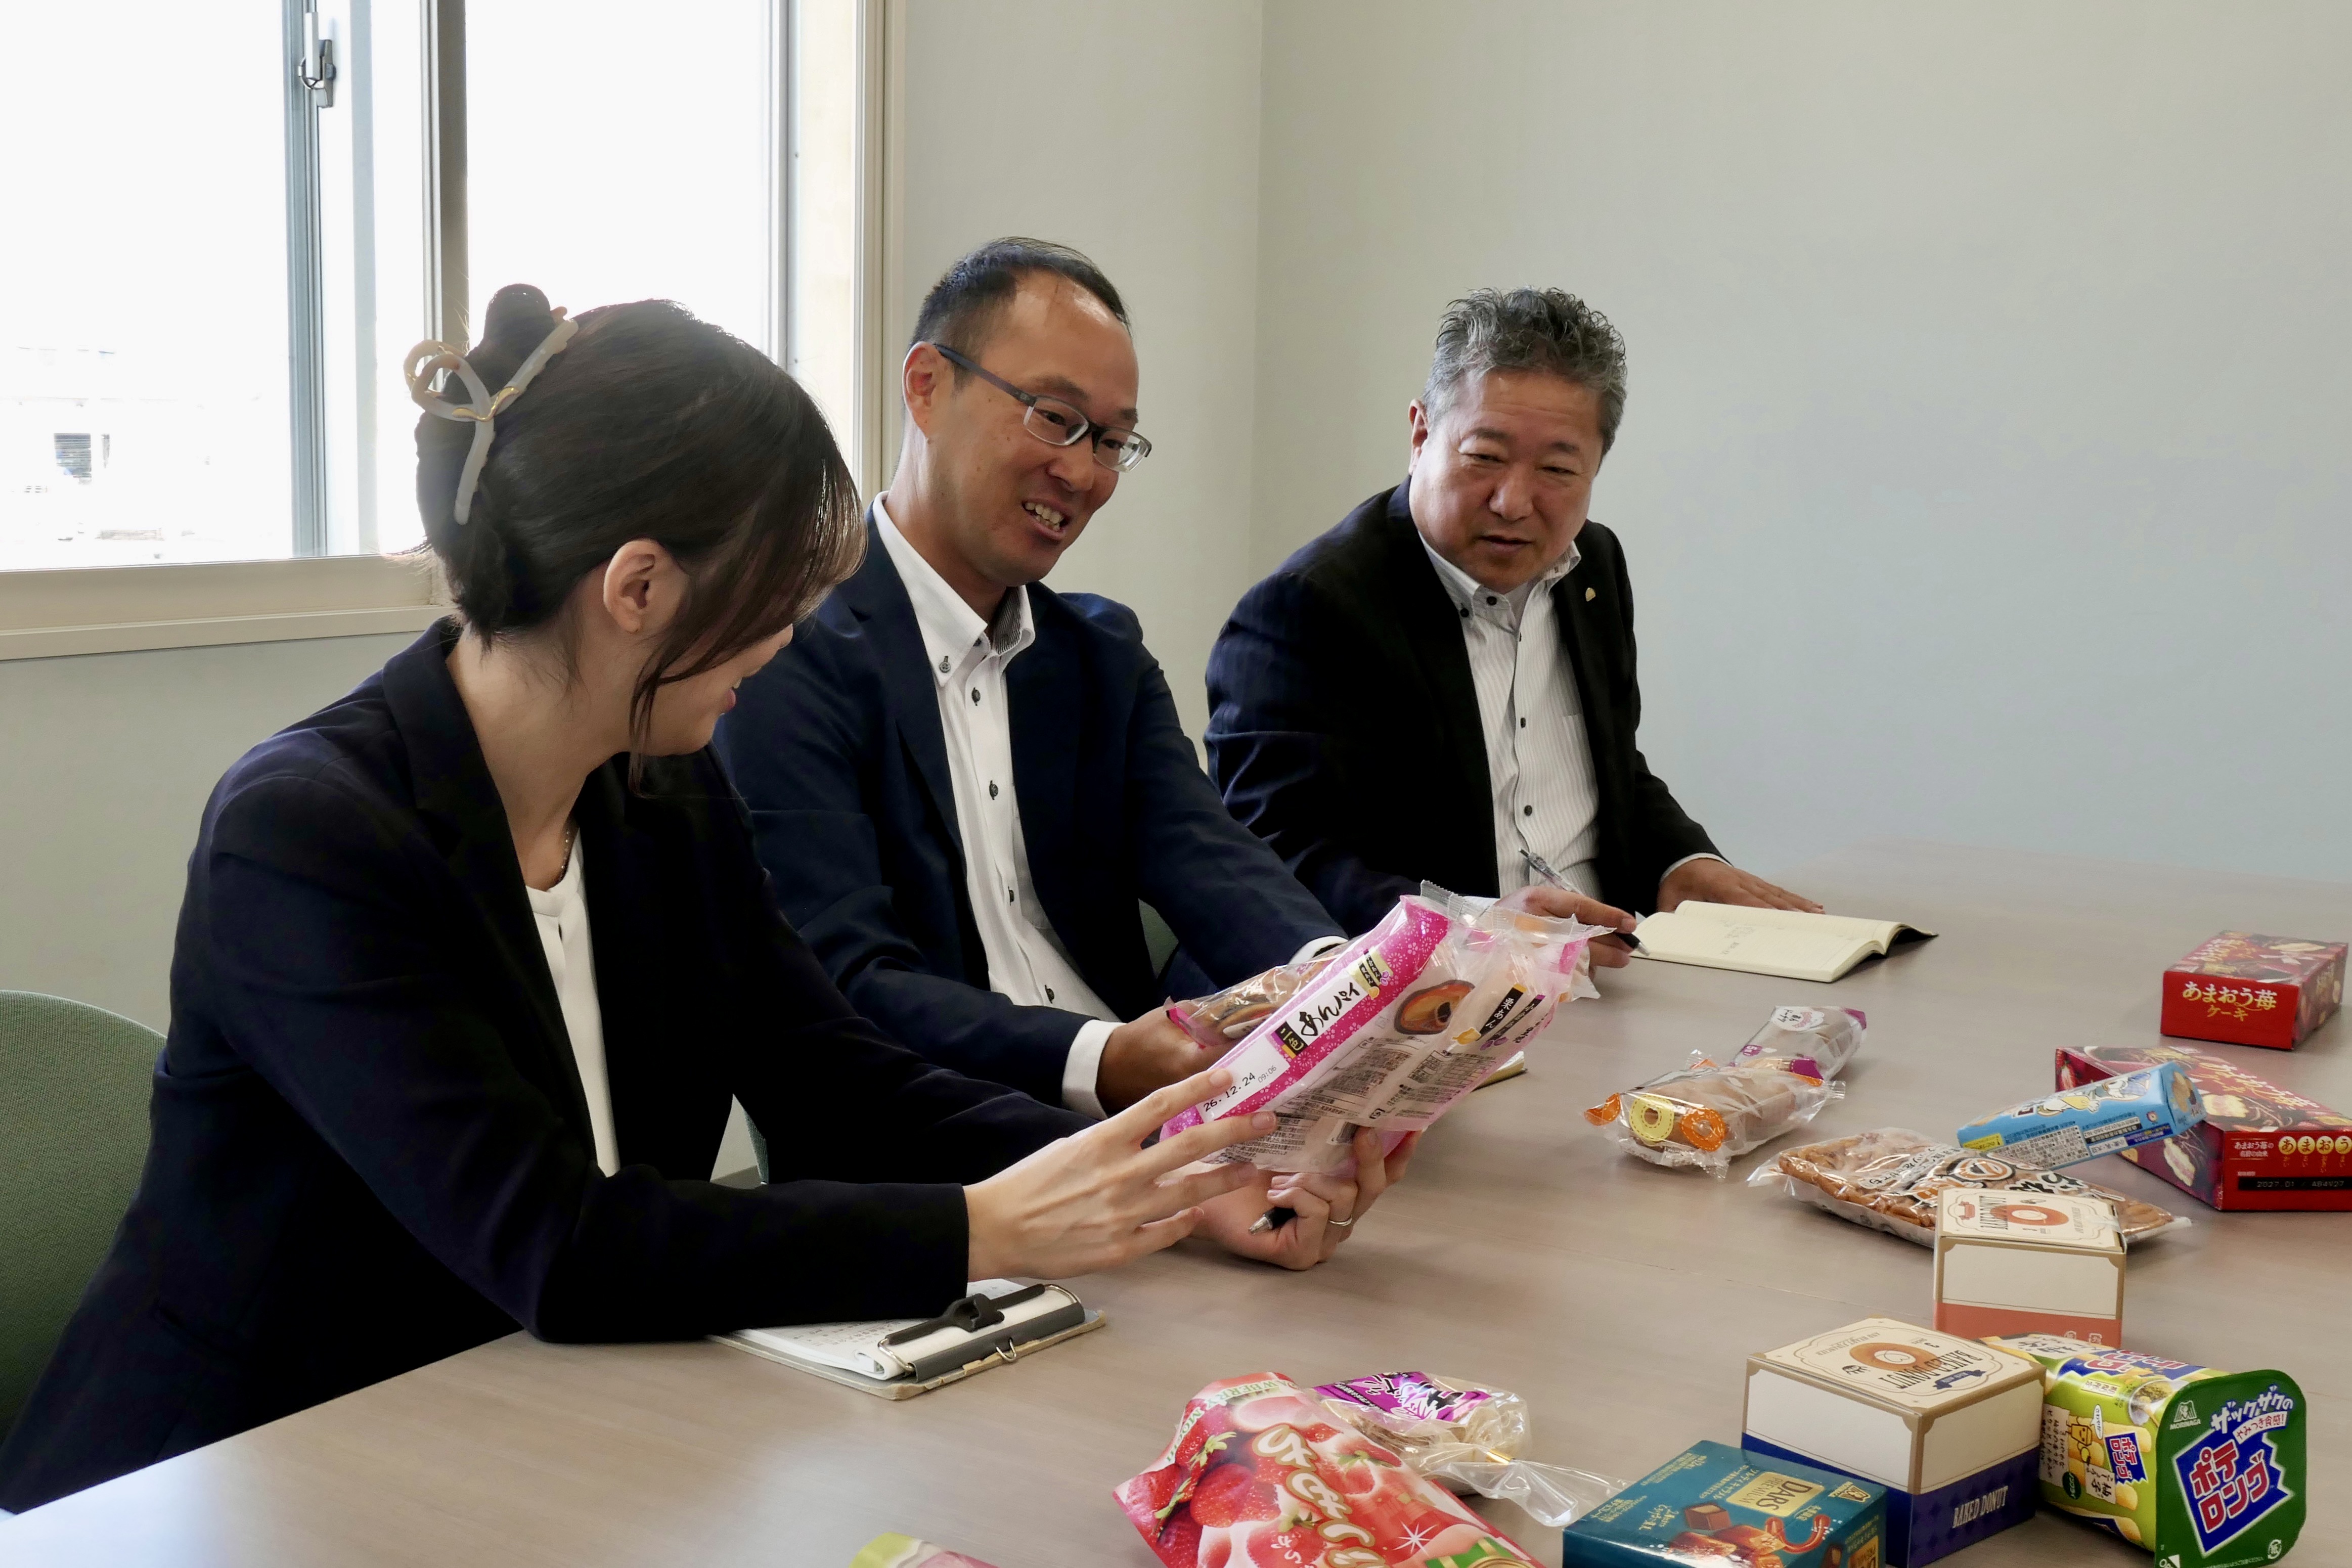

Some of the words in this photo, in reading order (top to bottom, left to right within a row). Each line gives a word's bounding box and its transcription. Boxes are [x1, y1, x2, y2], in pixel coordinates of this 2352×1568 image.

[1299, 981, 1360, 1036] あんパイ
[2183, 981, 2277, 1010] あまおう苺
[1483, 996, 1514, 1029] 栗あん
[2207, 1005, 2248, 1021] ケーキ
[1281, 1029, 1304, 1050] 二色
[1258, 1065, 1277, 1083] 09:06
[2282, 1139, 2294, 1151] あ
[2301, 1138, 2311, 1151] ま
[2320, 1139, 2331, 1151] お
[2338, 1138, 2348, 1151] う
[1979, 1195, 2007, 1213] DONUT
[1979, 1212, 2009, 1230] BAKED
[1918, 1350, 1986, 1372] BAKED
[1872, 1365, 1944, 1389] DONUT
[1166, 1408, 1203, 1462] MOCHI
[2170, 1419, 2201, 1430] MORINAGA
[2236, 1415, 2285, 1440] やみつき食感!
[2110, 1439, 2133, 1479] ロング
[2121, 1437, 2138, 1465] ポテ
[2190, 1439, 2239, 1498] ポテ
[1737, 1475, 1784, 1504] PREMIUM
[1751, 1479, 1814, 1512] DARS
[2091, 1479, 2112, 1497] 柚子
[2198, 1449, 2270, 1534] ロング
[1952, 1498, 1980, 1528] BAKED
[1980, 1486, 2009, 1516] DONUT
